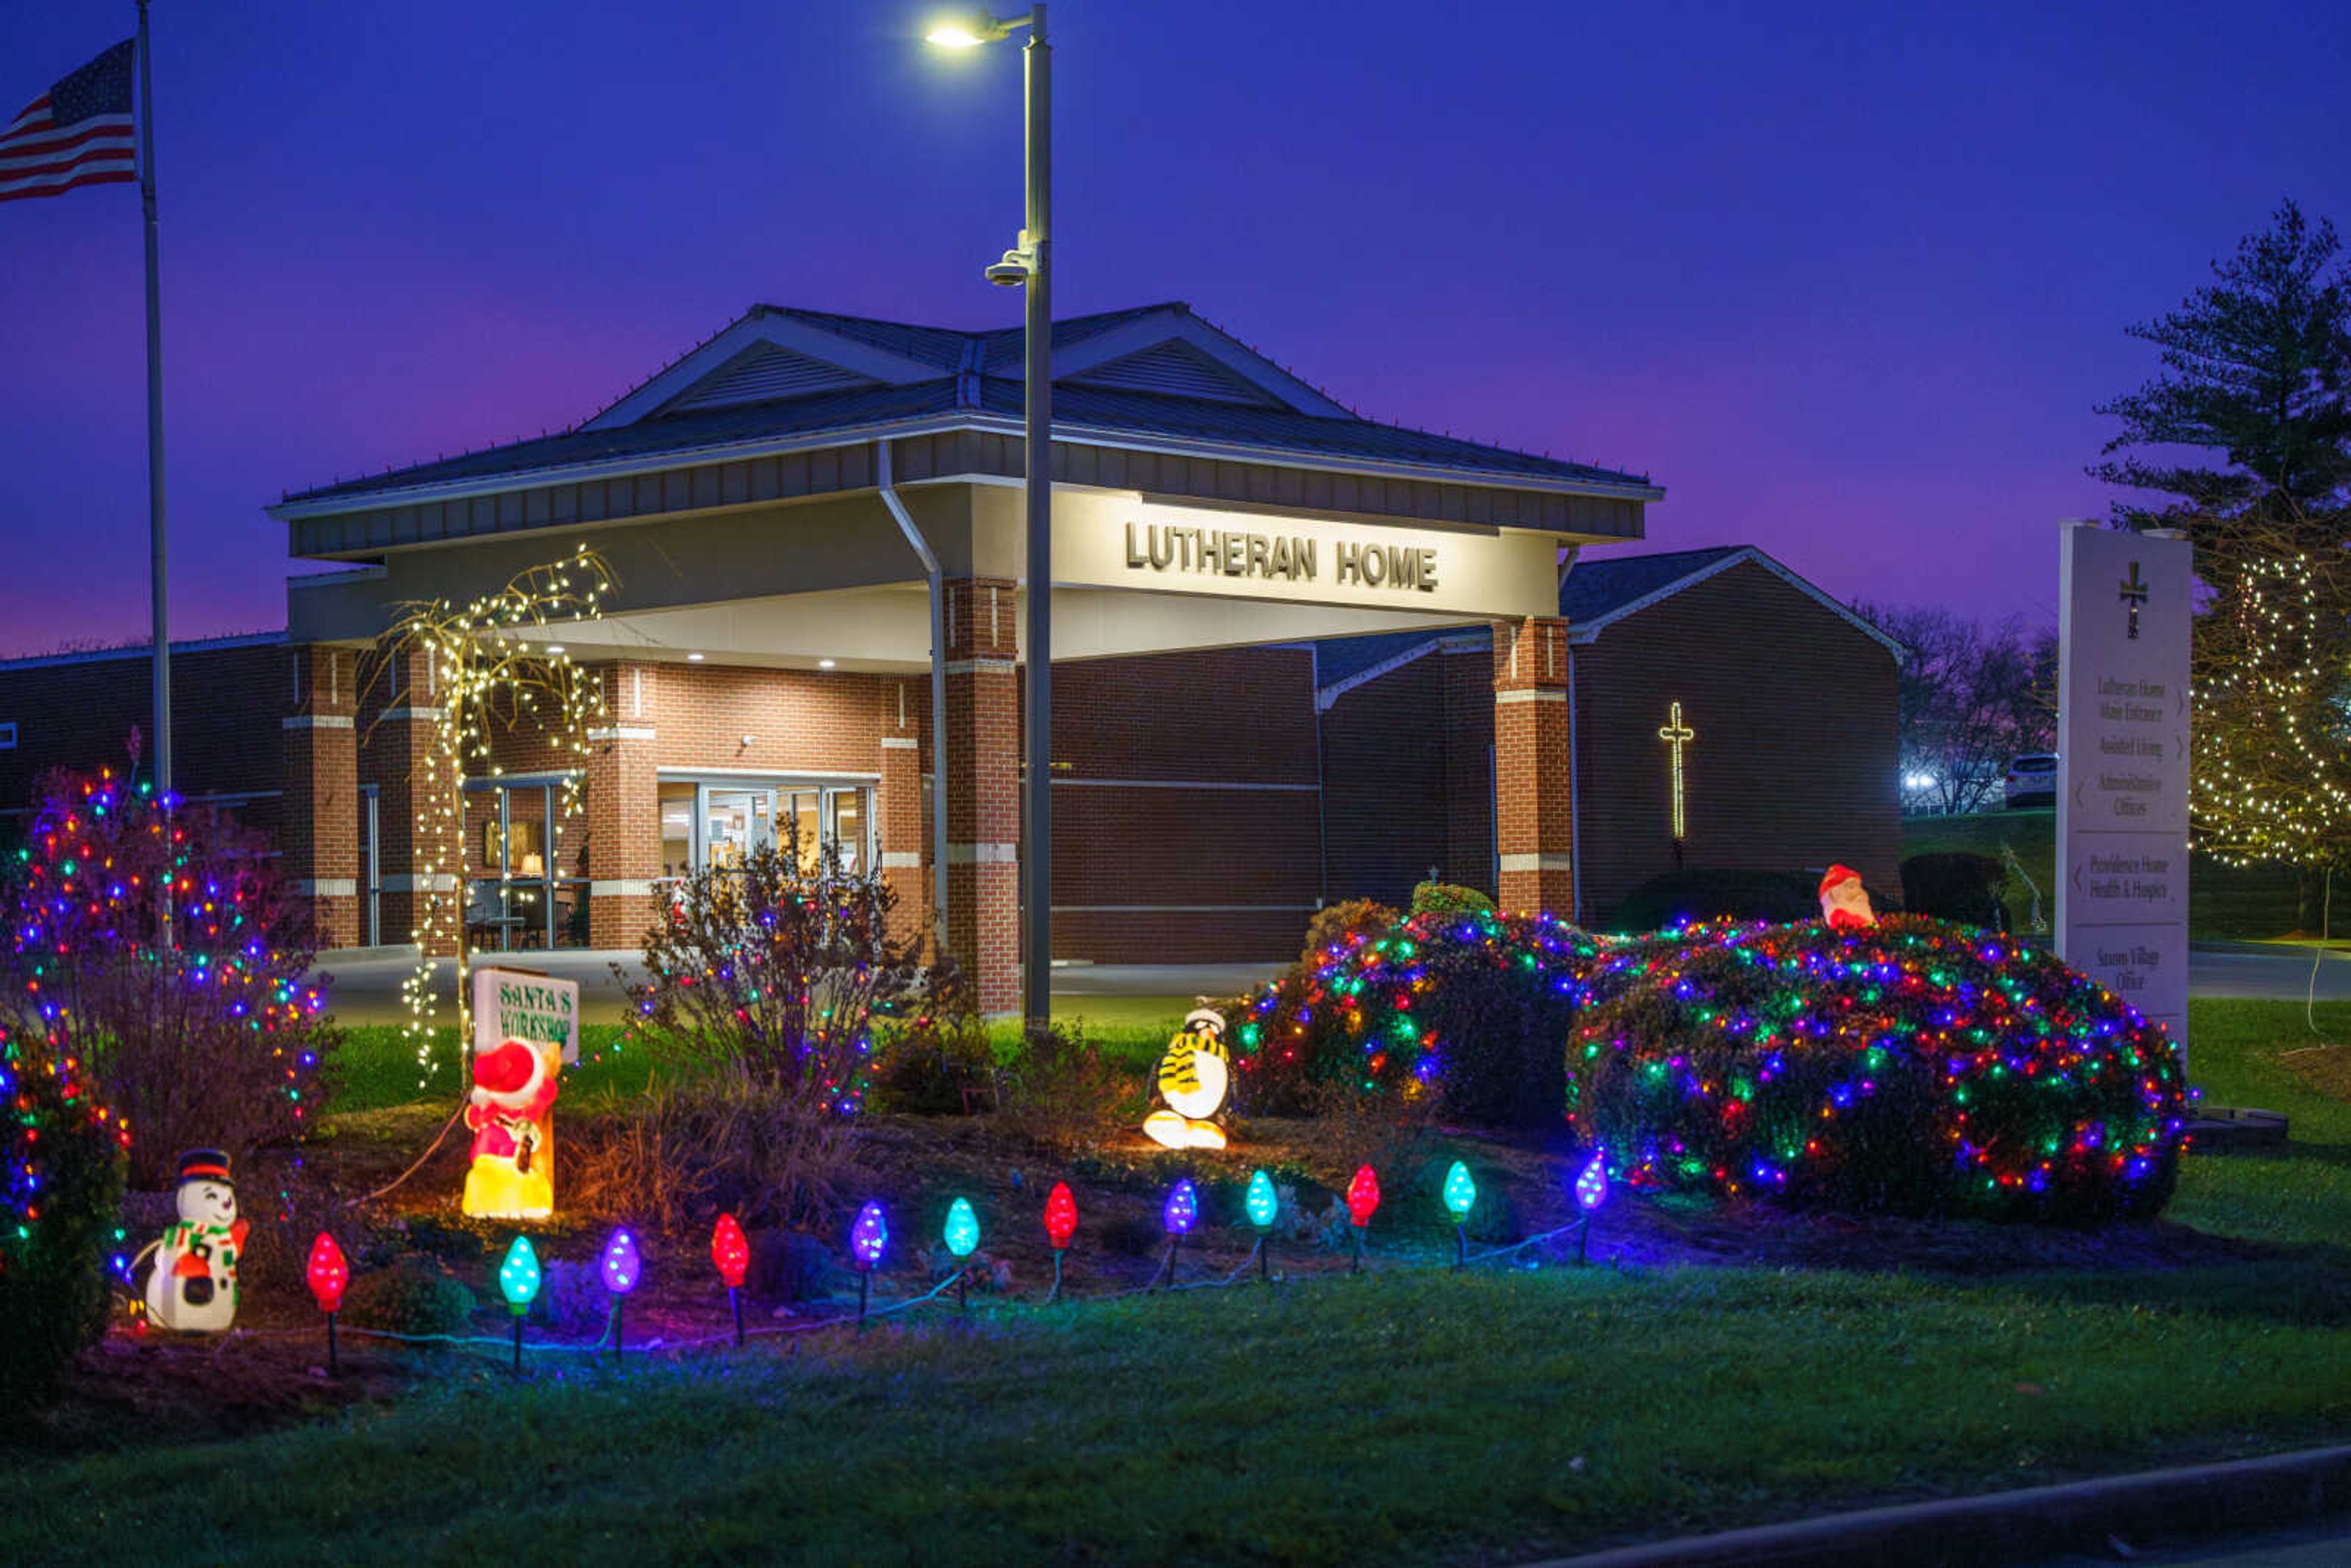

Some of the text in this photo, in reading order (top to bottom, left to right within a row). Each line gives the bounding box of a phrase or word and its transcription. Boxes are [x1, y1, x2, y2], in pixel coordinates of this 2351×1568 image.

[1126, 521, 1439, 592] LUTHERAN HOME
[500, 982, 571, 1015] SANTAS
[501, 1010, 571, 1041] WORKSHOP
